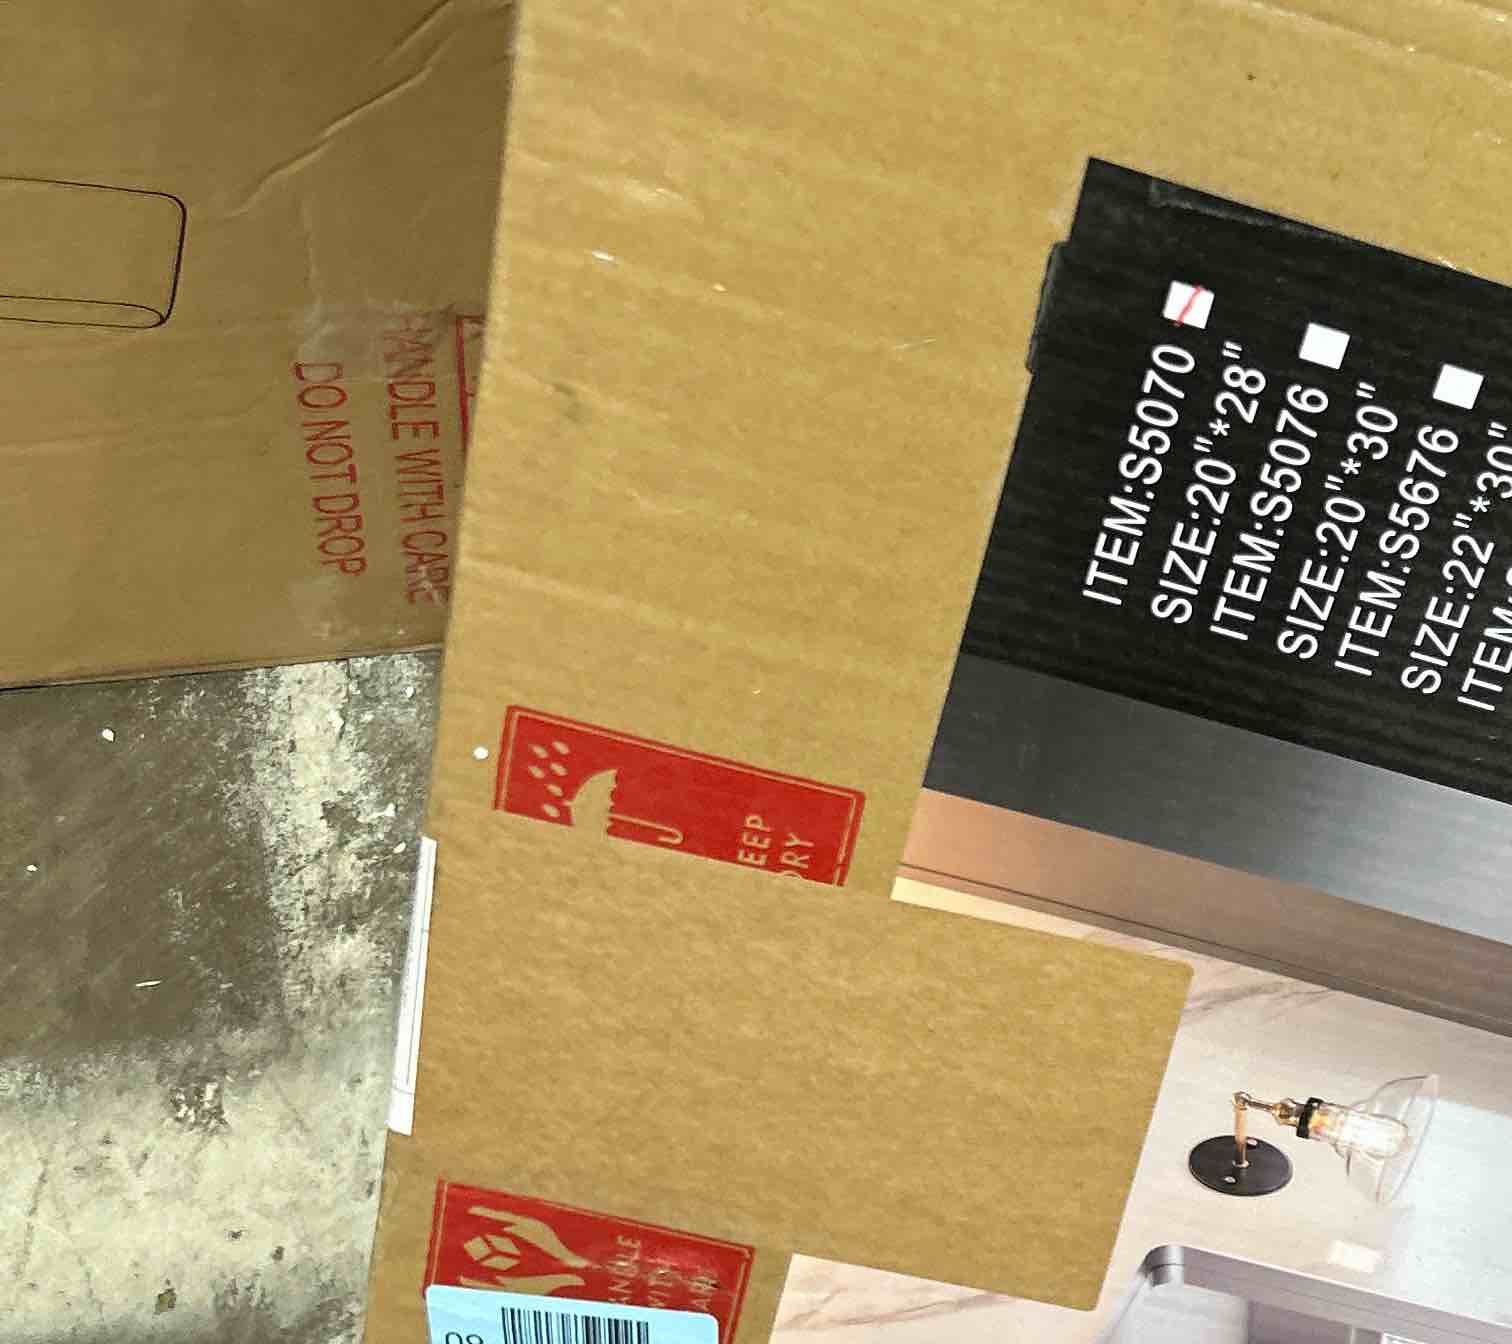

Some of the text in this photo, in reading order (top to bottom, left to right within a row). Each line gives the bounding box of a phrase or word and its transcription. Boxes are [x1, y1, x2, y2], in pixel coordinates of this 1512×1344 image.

[291, 360, 368, 578] DO NOT DROP
[397, 448, 448, 524] WITH
[1082, 344, 1195, 604] ITEM:S5070
[1209, 383, 1328, 640] ITEM:S5076
[1334, 424, 1458, 675] ITEM:S5676
[736, 813, 771, 867] EEP
